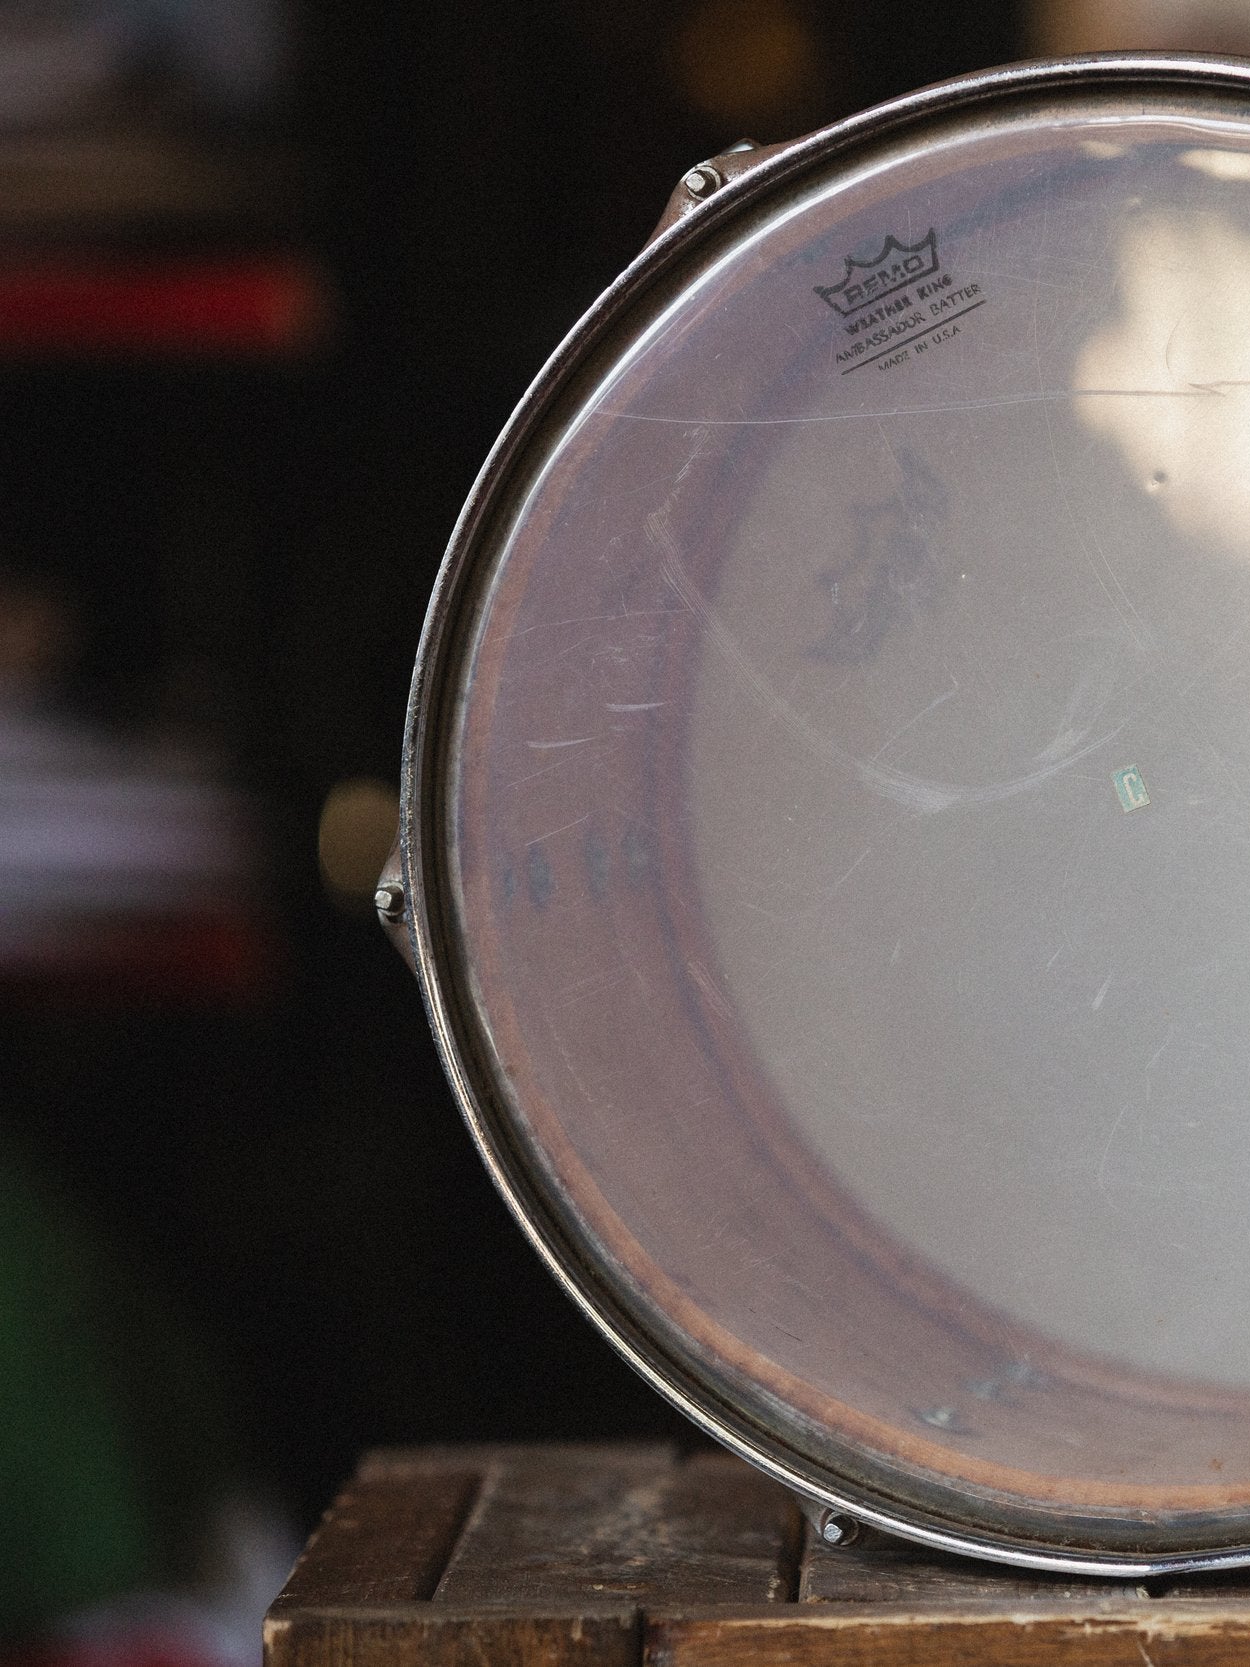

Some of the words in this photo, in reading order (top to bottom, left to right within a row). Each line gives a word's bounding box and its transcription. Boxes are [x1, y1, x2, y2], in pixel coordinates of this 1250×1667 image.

[844, 255, 924, 305] REMO
[916, 274, 953, 300] KING
[836, 312, 927, 363] AMBASSADOR
[930, 284, 982, 315] BATTER
[878, 350, 910, 372] MADE
[914, 341, 929, 354] IN
